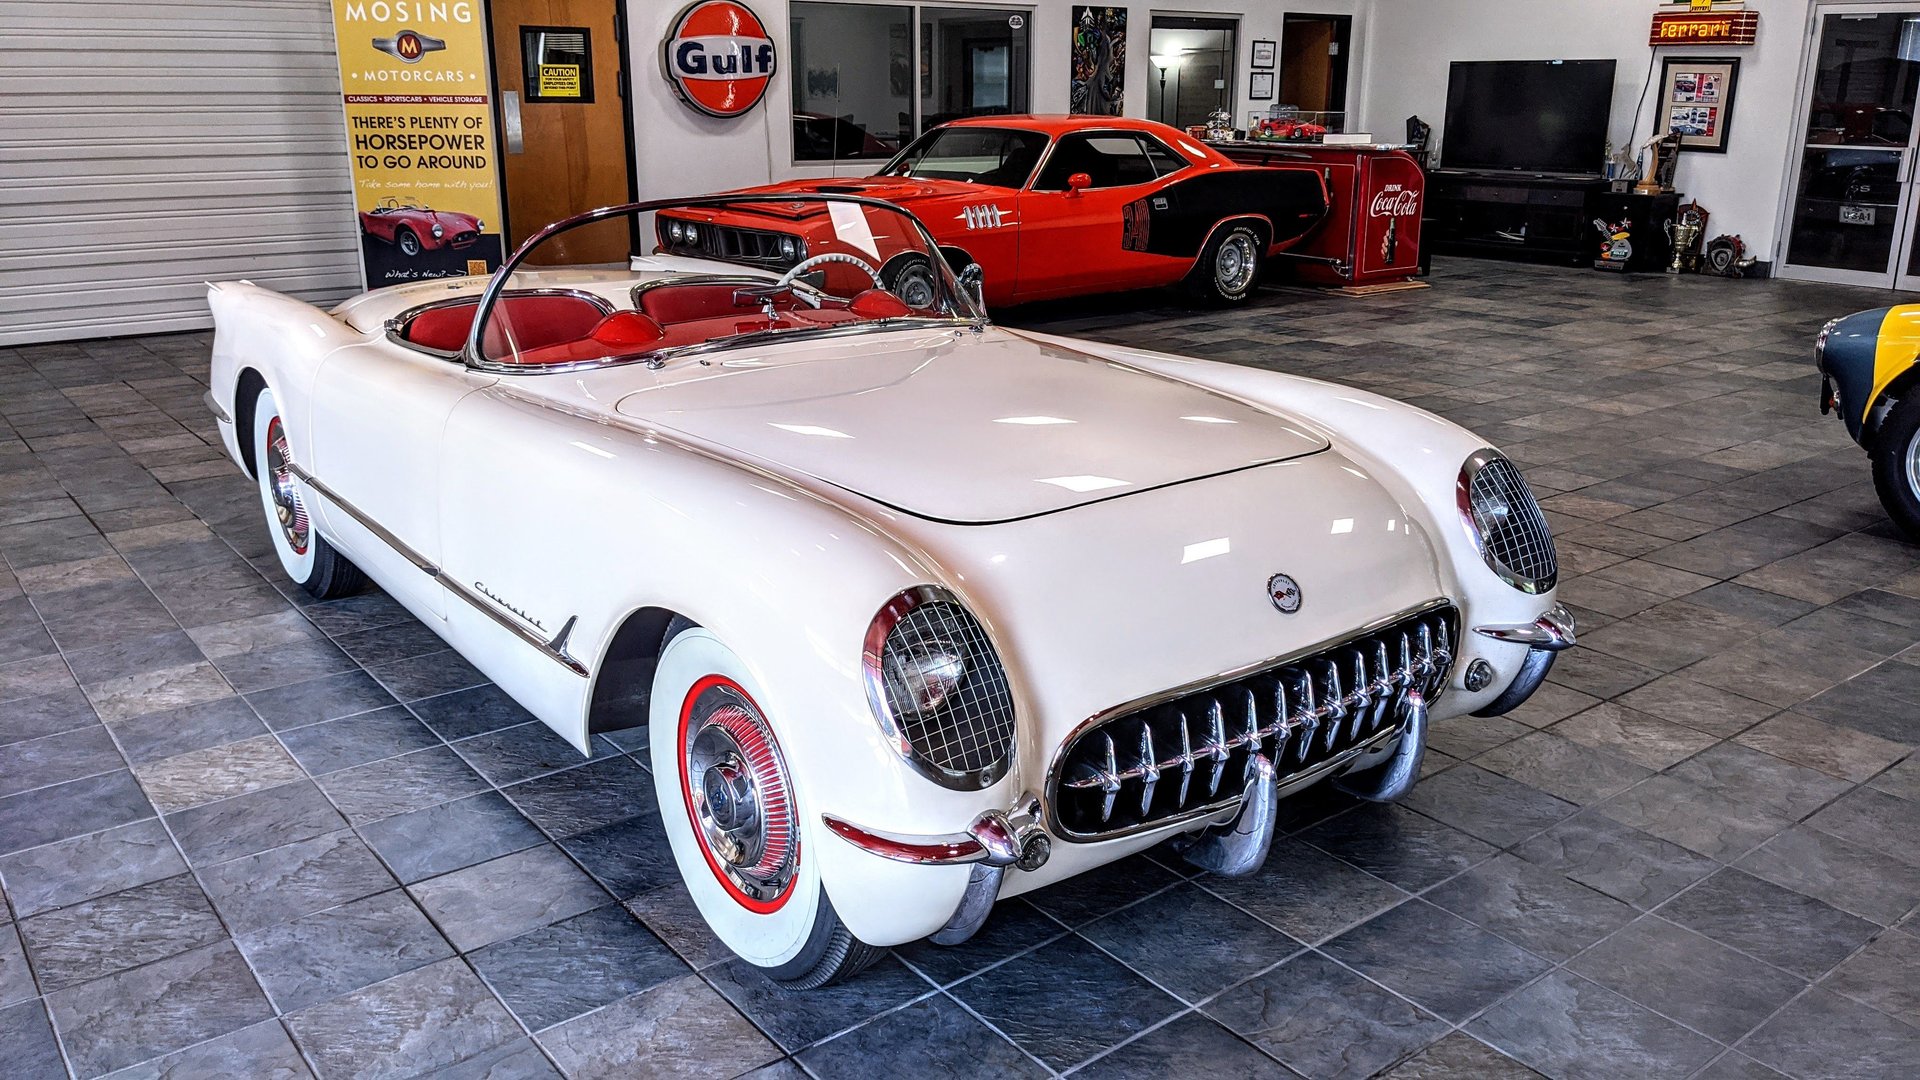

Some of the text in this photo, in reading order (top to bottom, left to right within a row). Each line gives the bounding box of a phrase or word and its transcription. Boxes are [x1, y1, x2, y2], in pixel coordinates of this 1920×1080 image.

[345, 1, 472, 23] MOSING
[1660, 20, 1732, 38] Ferrari
[401, 38, 418, 54] M
[676, 41, 772, 74] Gulf
[364, 70, 464, 82] MOTORCARS
[543, 68, 576, 76] CAUTION
[348, 95, 378, 103] CLASSICS
[383, 95, 422, 103] SPORTSCARS
[352, 116, 483, 129] THERE'S PLENTY OF
[355, 134, 485, 150] HORSEPOWER
[356, 155, 487, 169] TO GO AROUND
[359, 179, 493, 190] Take some home with you!
[1384, 184, 1402, 192] DRINK
[384, 268, 446, 278] What's New?
